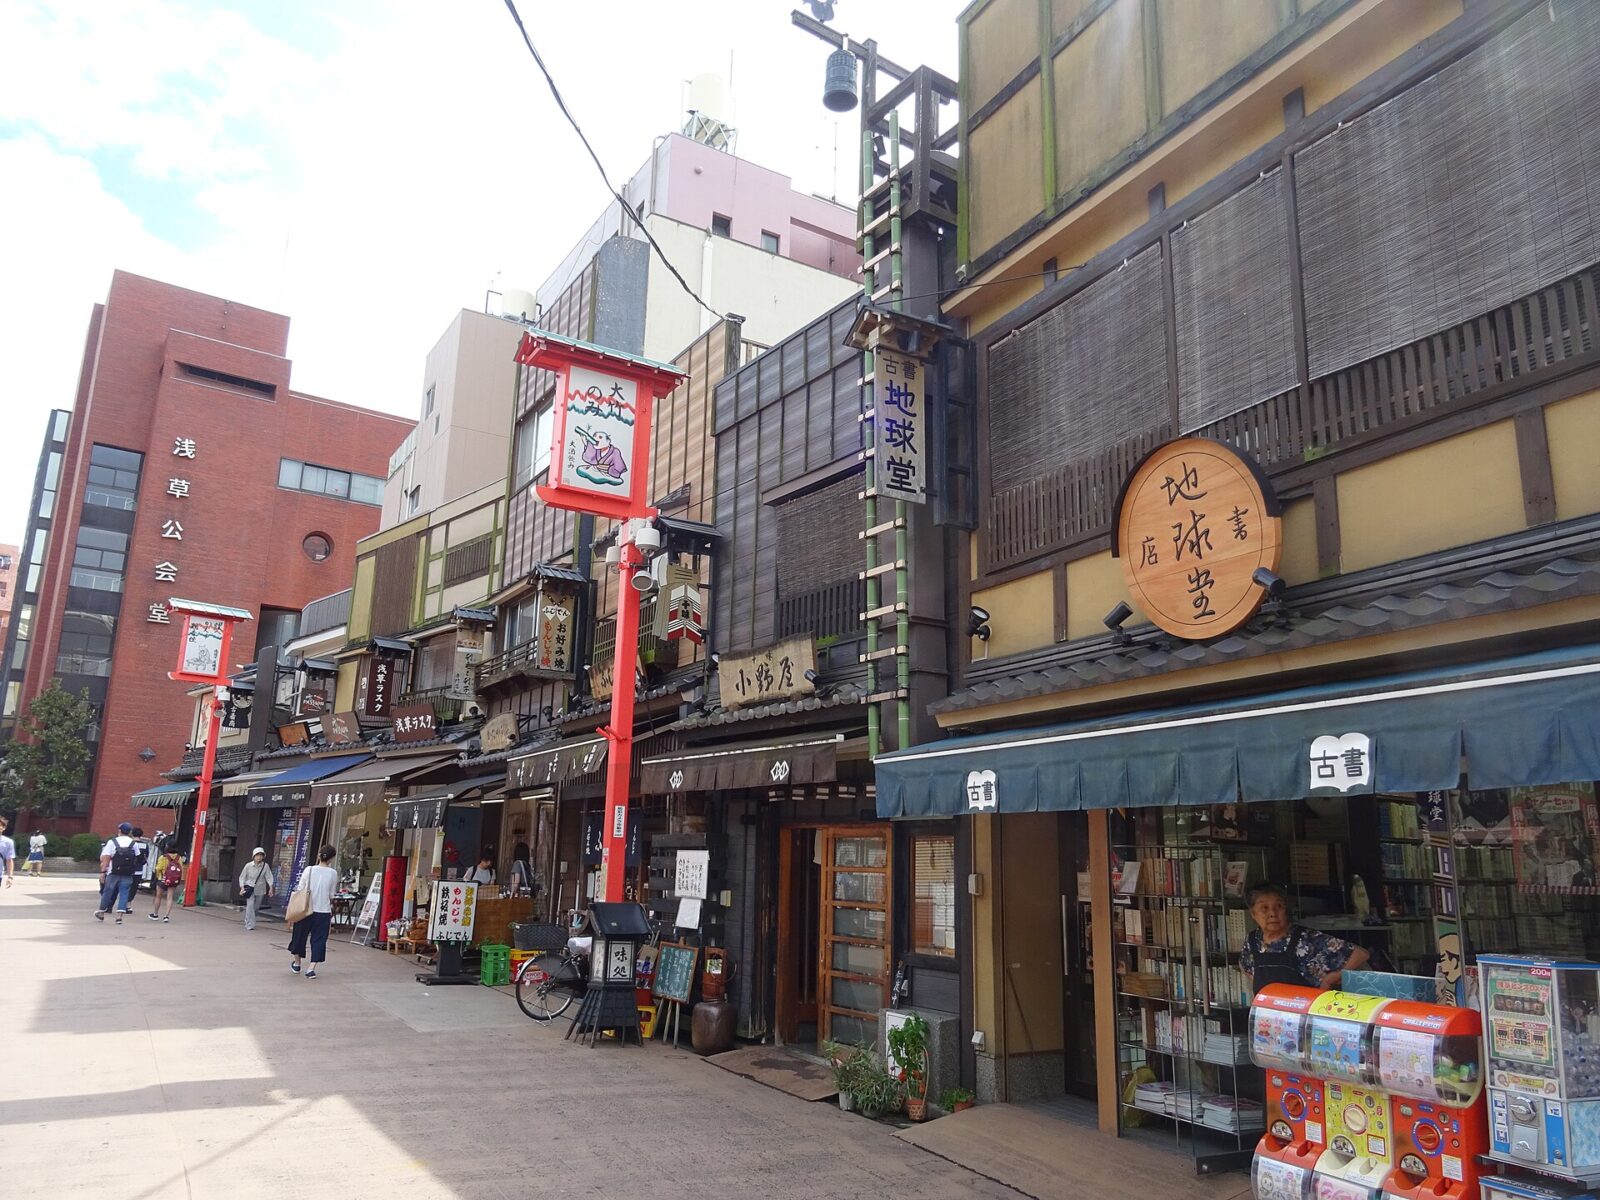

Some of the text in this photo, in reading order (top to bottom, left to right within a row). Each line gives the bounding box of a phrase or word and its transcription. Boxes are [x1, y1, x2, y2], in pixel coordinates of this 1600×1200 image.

[883, 355, 917, 380] 古書
[585, 385, 603, 417] のみ
[609, 382, 625, 418] 大竹
[885, 380, 917, 494] 地球堂
[147, 437, 196, 624] 浅草公会堂
[1160, 461, 1215, 619] 地球堂
[554, 623, 567, 669] お好み焼
[373, 663, 387, 712] 浅草ラスク
[735, 656, 794, 696] 小野屋
[395, 714, 431, 733] 浅草ラスク
[1310, 747, 1365, 779] 古書
[326, 793, 364, 807] 浅草ラスク
[968, 780, 994, 801] 古書
[438, 886, 449, 926] 鉄板焼
[451, 887, 462, 924] もんじゃ
[436, 931, 470, 940] ふじでん
[613, 946, 627, 977] 味処
